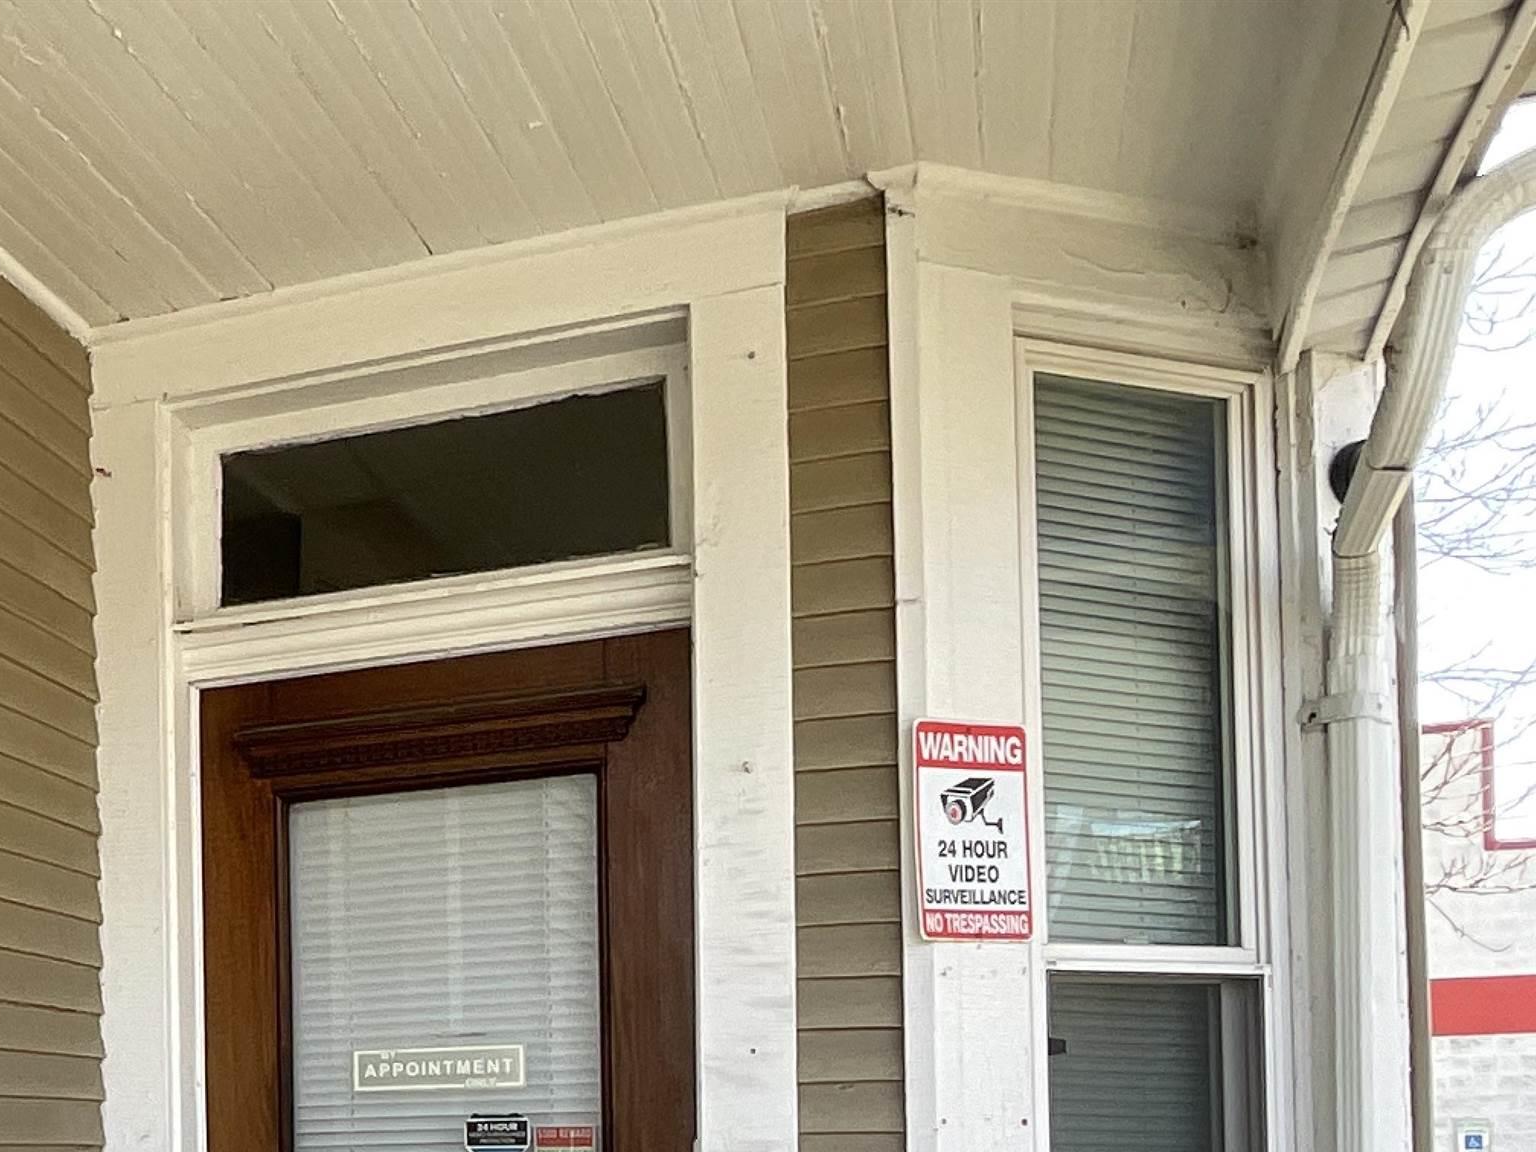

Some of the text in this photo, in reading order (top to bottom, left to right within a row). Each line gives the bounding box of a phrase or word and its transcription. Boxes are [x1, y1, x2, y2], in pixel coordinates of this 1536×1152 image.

[918, 731, 1023, 765] WARNING
[938, 839, 1008, 859] 24 HOUR
[948, 865, 1000, 883] VIDEO
[925, 889, 1027, 905] SURVEILLANCE
[926, 912, 1029, 935] NO TRESPASSING
[364, 1057, 513, 1079] APPOINTMENT
[465, 1077, 497, 1088] ONLY
[489, 1122, 518, 1132] HOUR
